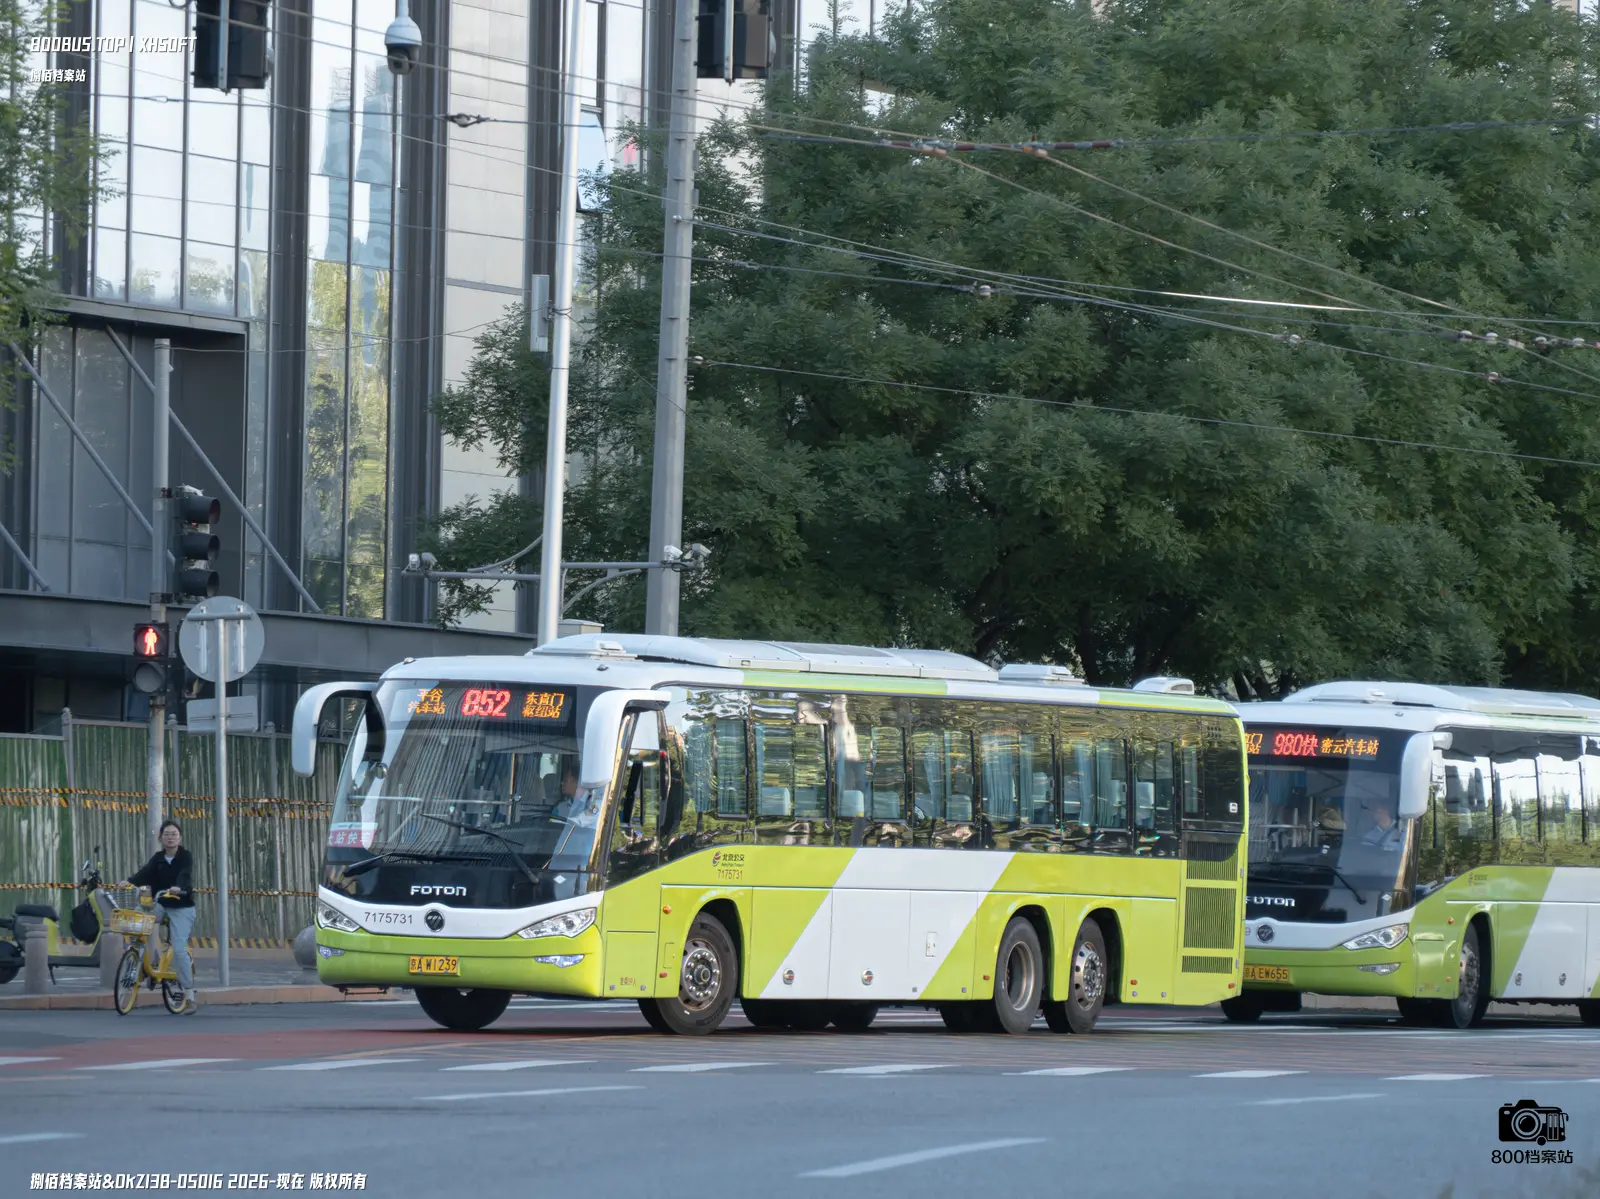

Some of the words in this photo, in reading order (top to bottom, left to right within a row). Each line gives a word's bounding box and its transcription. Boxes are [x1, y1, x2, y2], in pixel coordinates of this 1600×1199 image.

[416, 689, 444, 702] 平谷
[525, 692, 565, 706] 东直门
[407, 702, 446, 714] 汽车站
[461, 688, 511, 717] 852
[1272, 732, 1318, 756] 980快
[1320, 738, 1380, 756] 密云汽车站
[717, 869, 743, 880] 7175731
[410, 885, 467, 896] FOTON
[364, 912, 413, 924] 7175731
